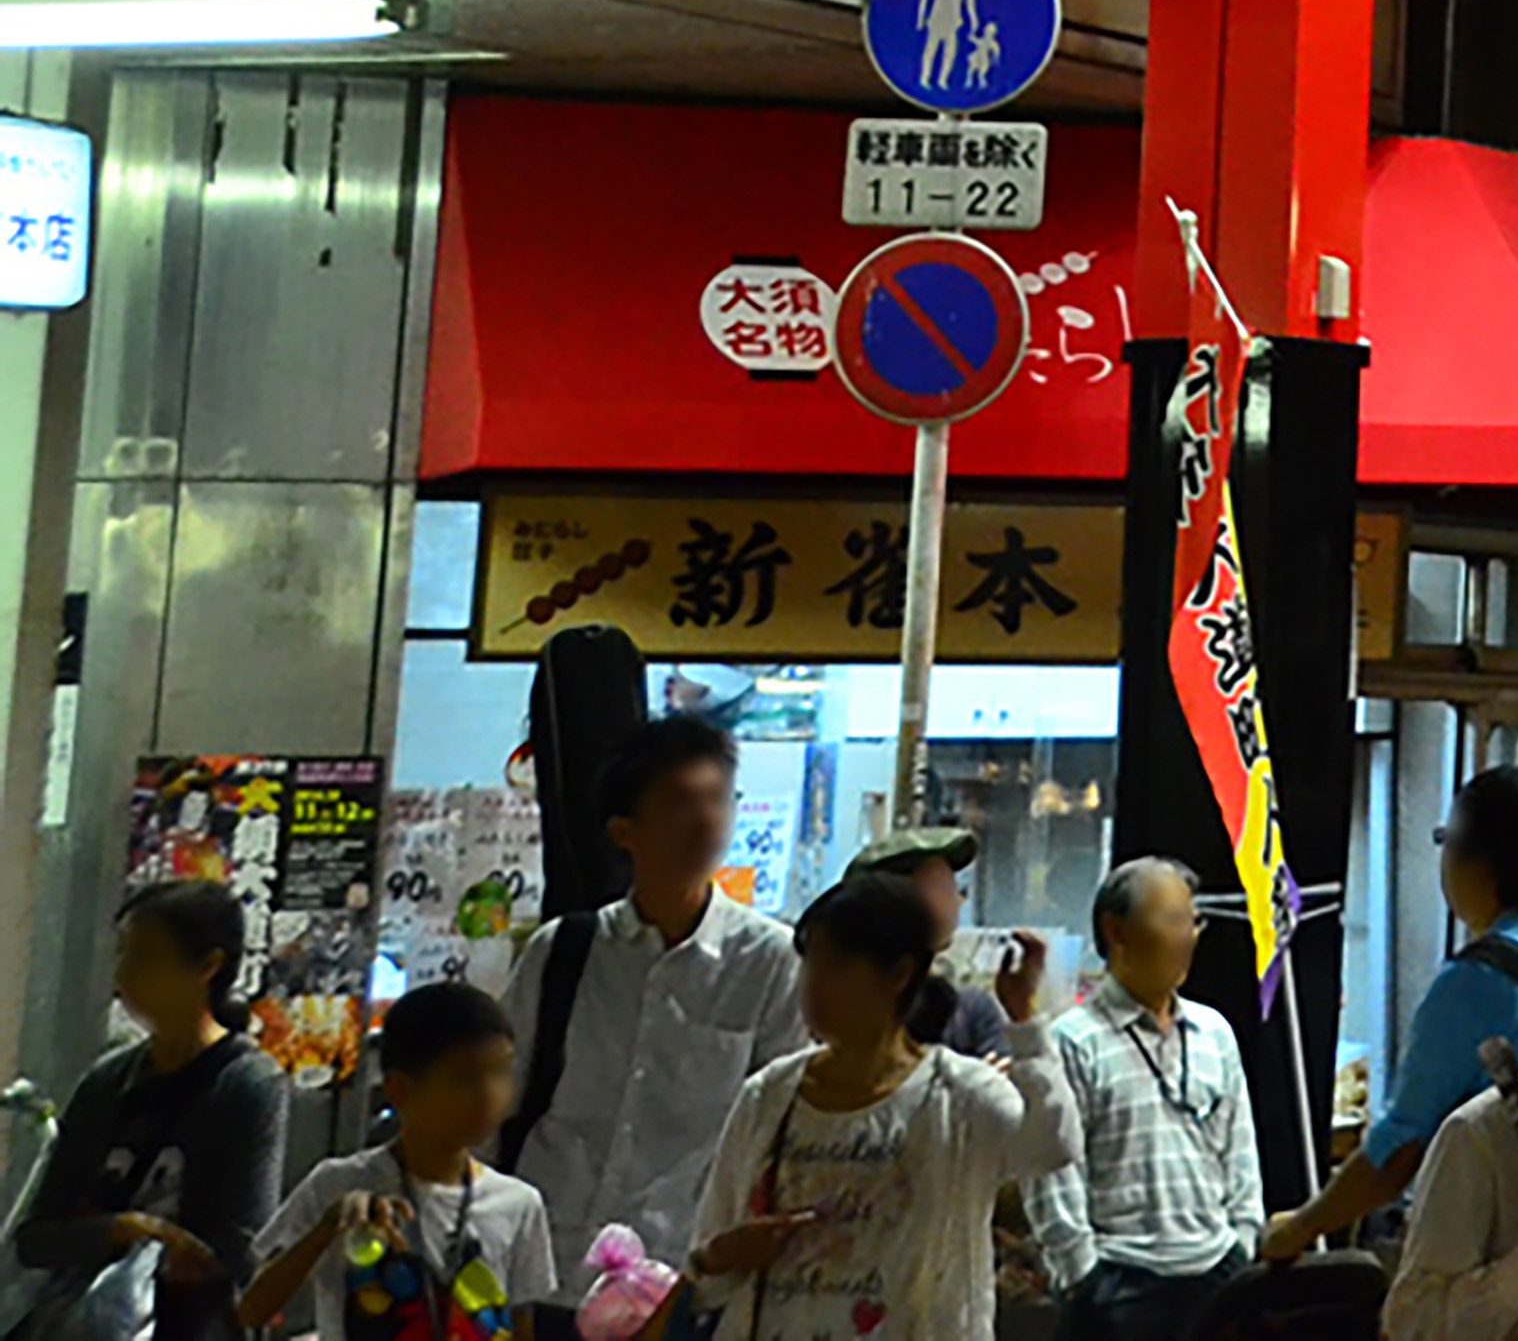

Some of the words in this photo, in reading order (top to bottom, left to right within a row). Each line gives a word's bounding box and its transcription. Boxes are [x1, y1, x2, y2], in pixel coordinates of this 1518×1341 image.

[855, 130, 1038, 169] 軽車両を除く
[866, 178, 1020, 218] 11-22
[716, 278, 820, 316] 大須
[722, 321, 827, 360] 名物
